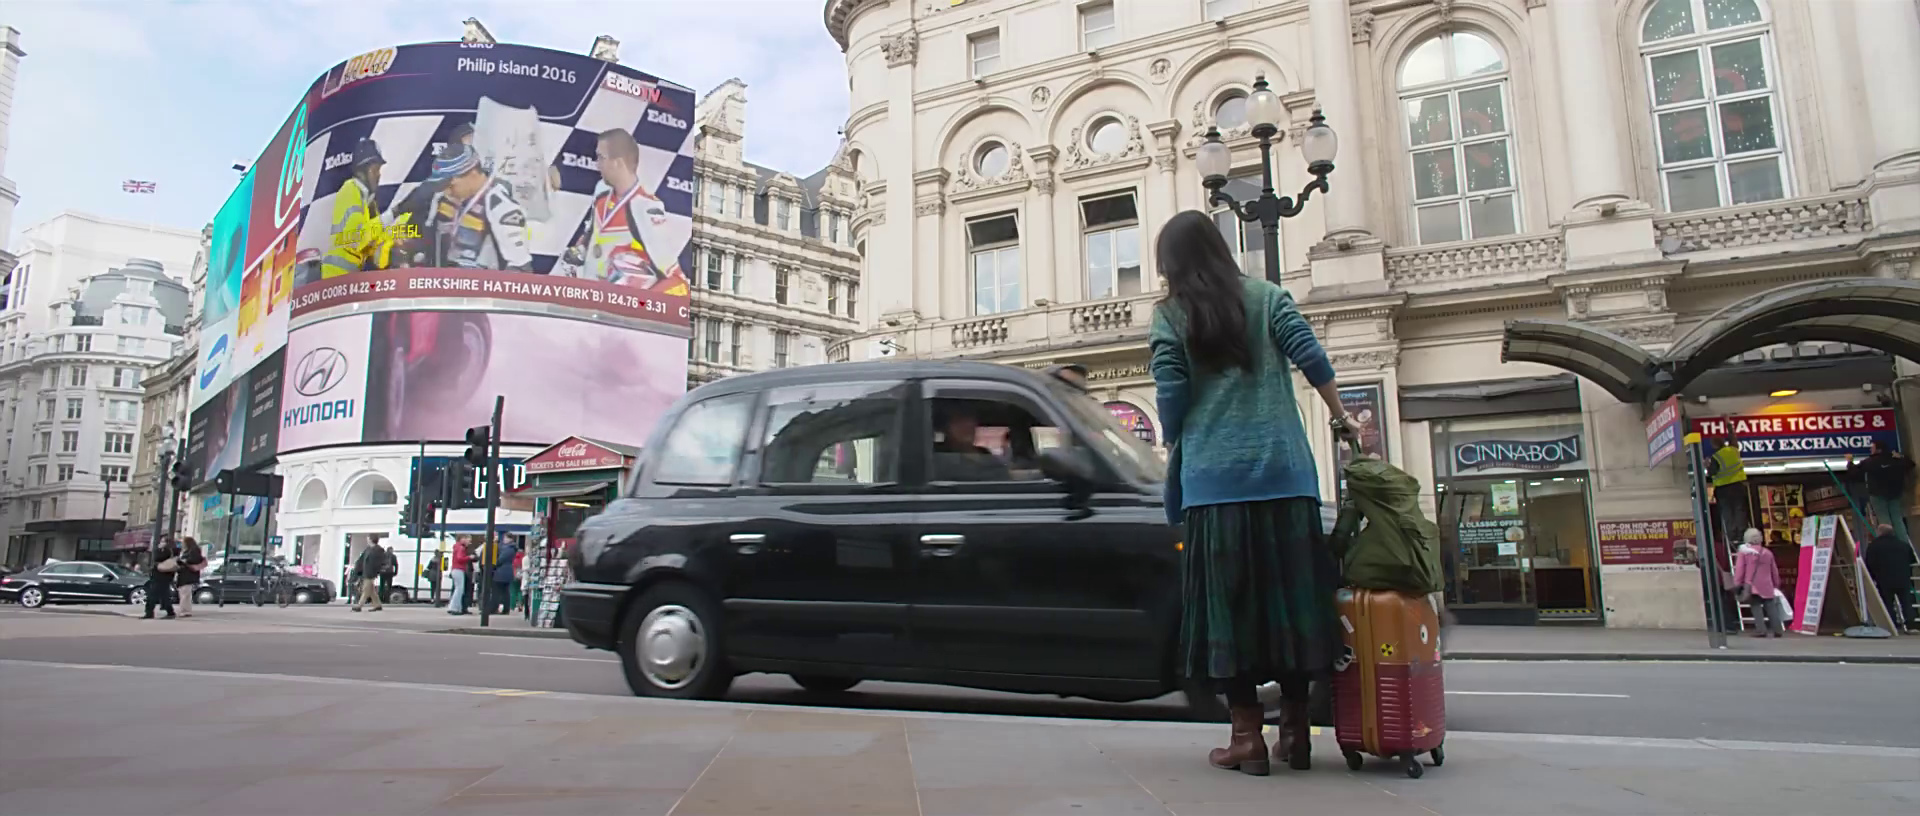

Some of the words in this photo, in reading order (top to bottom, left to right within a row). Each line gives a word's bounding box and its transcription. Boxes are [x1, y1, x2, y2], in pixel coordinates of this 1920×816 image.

[457, 57, 495, 75] Philip
[499, 60, 539, 77] island
[541, 65, 576, 84] 2016
[647, 109, 687, 129] Edko
[322, 284, 347, 300] COORS
[349, 281, 370, 294] 84.22
[375, 279, 397, 292] 2.52
[409, 277, 479, 291] BERKSHIRE
[607, 292, 639, 308] 124.76
[646, 300, 666, 314] 3.31
[283, 399, 354, 428] HYUNDAI
[1787, 414, 1865, 431] TICKETS
[1872, 415, 1885, 427] &
[1458, 438, 1578, 464] CINNABON
[1778, 435, 1873, 451] EXCHANGE
[555, 460, 565, 468] ON
[566, 459, 580, 467] SALE
